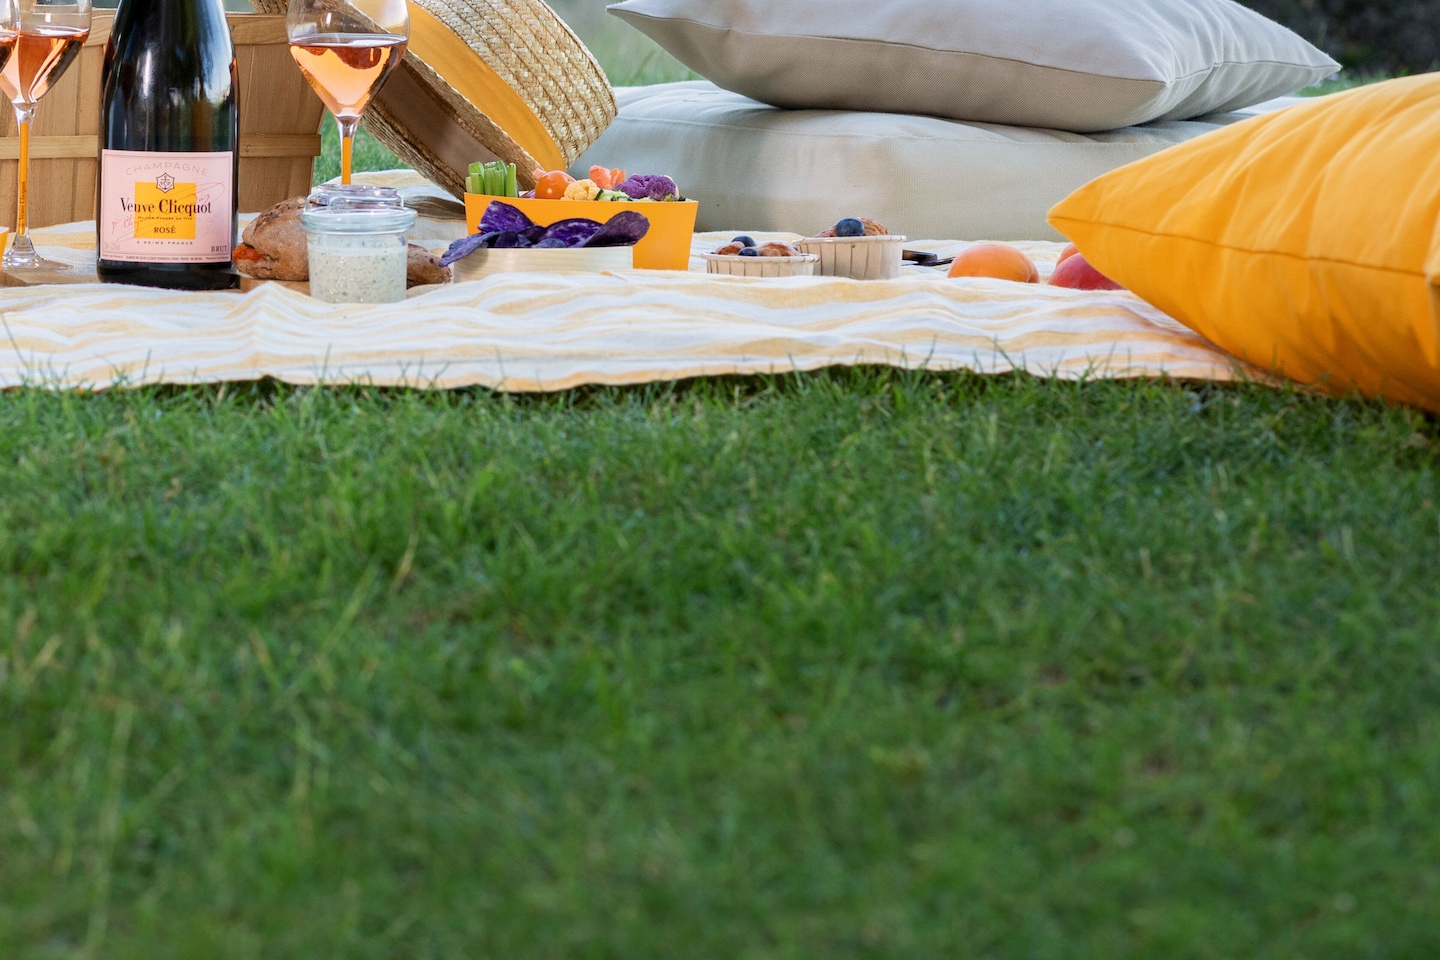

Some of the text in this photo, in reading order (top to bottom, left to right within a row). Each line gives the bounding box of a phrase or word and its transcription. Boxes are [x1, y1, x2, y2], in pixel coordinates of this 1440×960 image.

[125, 161, 209, 176] CHAMPAGNE
[120, 197, 155, 213] Veuve
[159, 199, 212, 216] Clicquot
[153, 226, 176, 234] ROSÉ
[211, 245, 228, 253] BRUT
